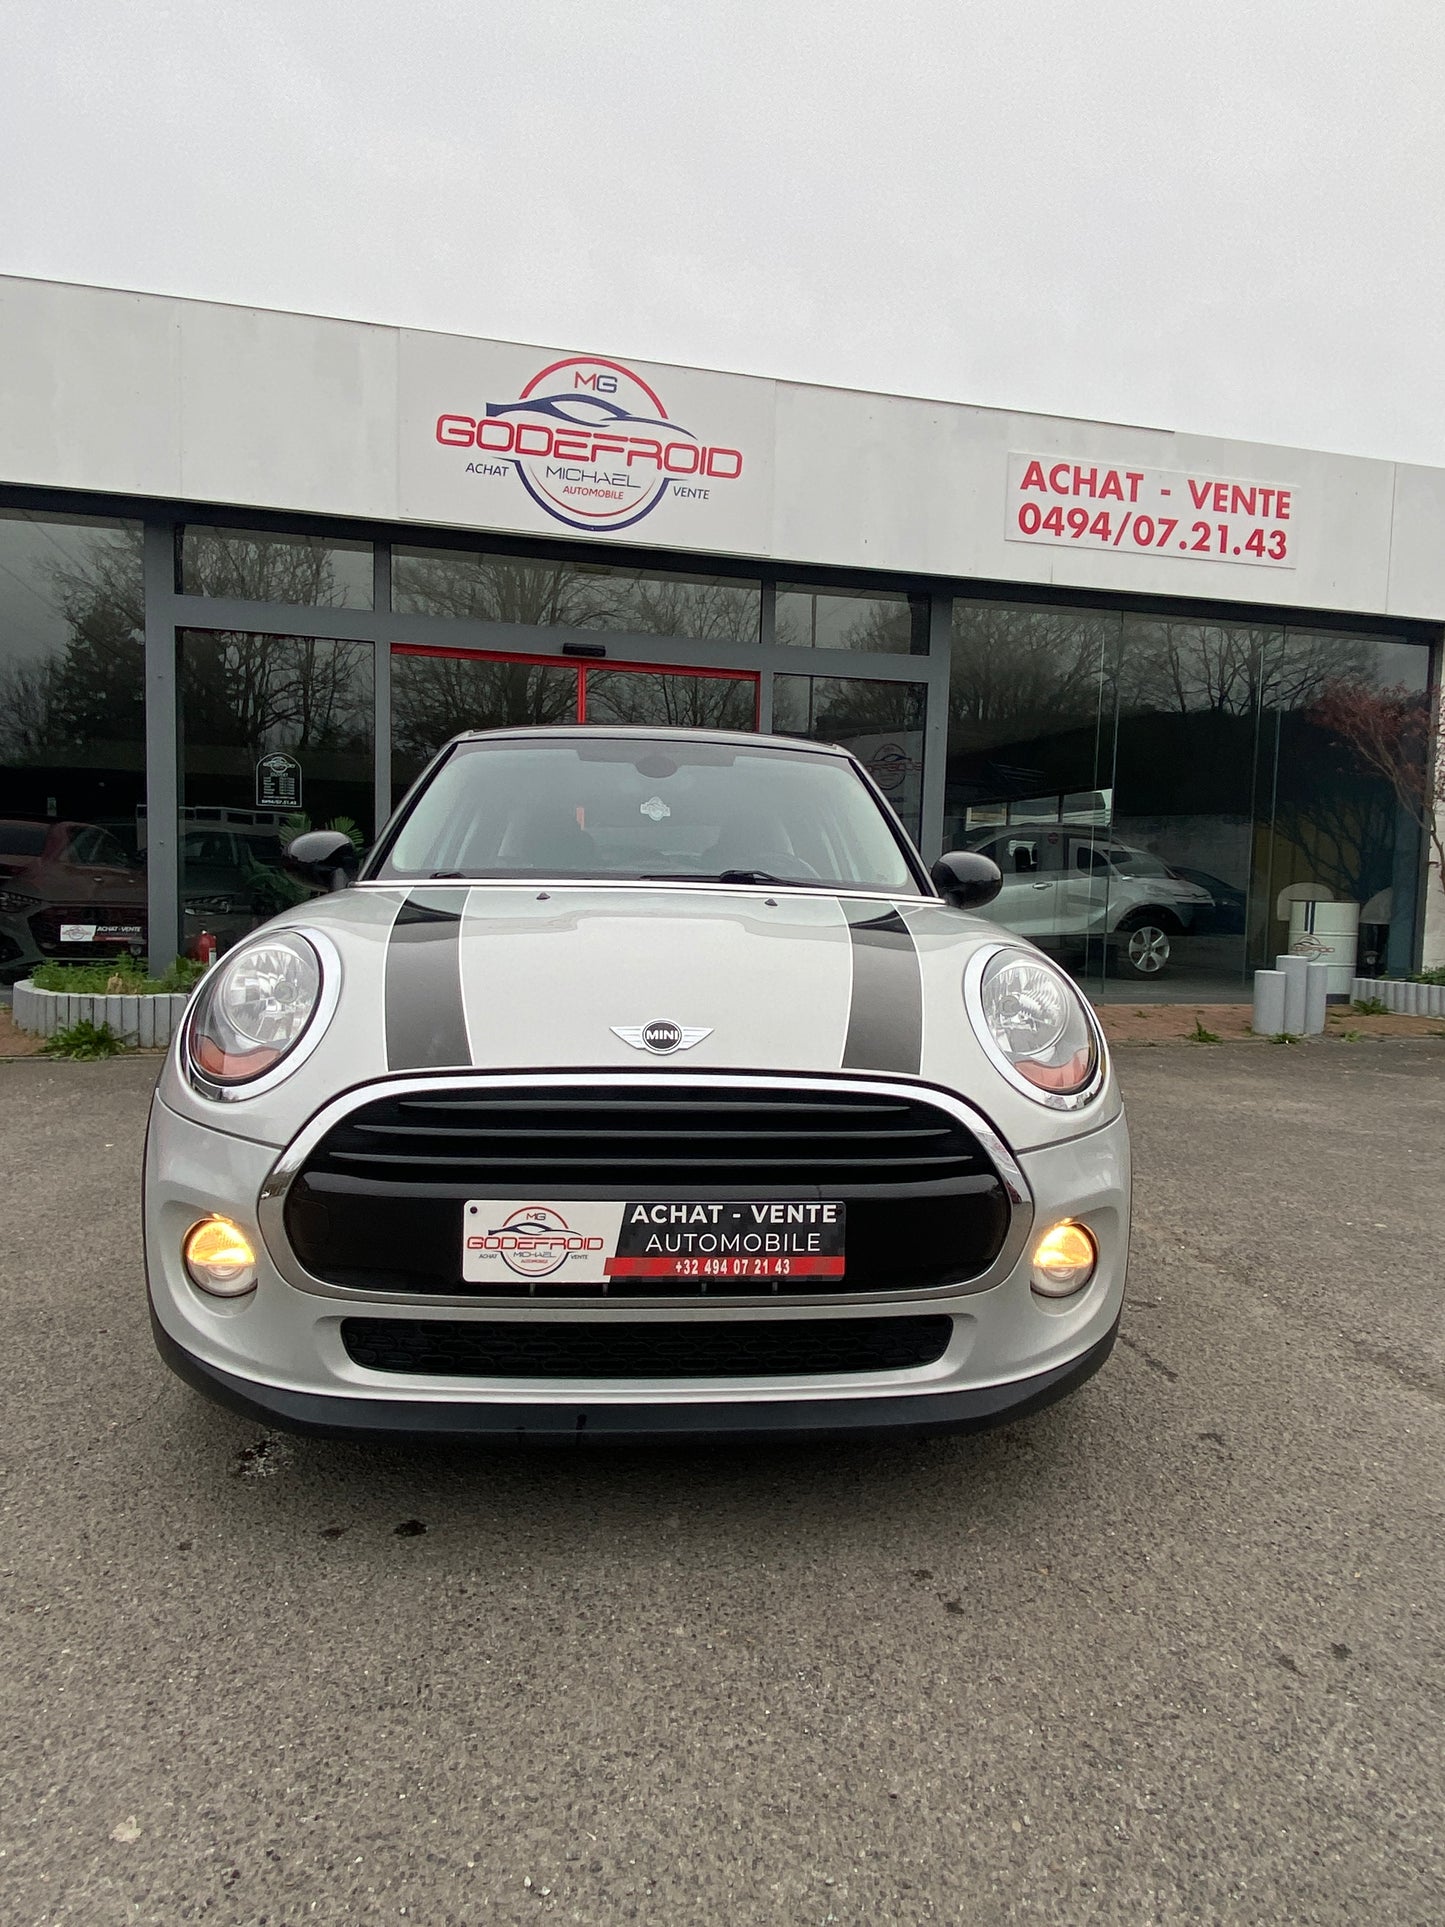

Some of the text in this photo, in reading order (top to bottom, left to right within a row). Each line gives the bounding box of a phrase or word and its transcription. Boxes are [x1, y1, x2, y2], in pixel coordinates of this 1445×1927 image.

[574, 371, 618, 393] MG
[436, 414, 743, 479] GODEFROID
[465, 462, 509, 478] ACHAT
[546, 465, 641, 489] MICHAEL
[562, 486, 624, 500] AUTOMOBILE
[673, 486, 710, 500] VENTE
[1020, 461, 1144, 503] ACHAT
[1188, 479, 1291, 519] VENTE
[1018, 502, 1288, 560] 0494/07.21.43
[646, 1029, 679, 1041] MINI
[526, 1212, 546, 1221] MG
[630, 1204, 724, 1224] ACHAT
[751, 1204, 837, 1224] VENTE
[467, 1236, 604, 1250] GODEFROID
[645, 1233, 821, 1252] AUTOMOBILE
[675, 1259, 790, 1275] +32 494 07 21 43
